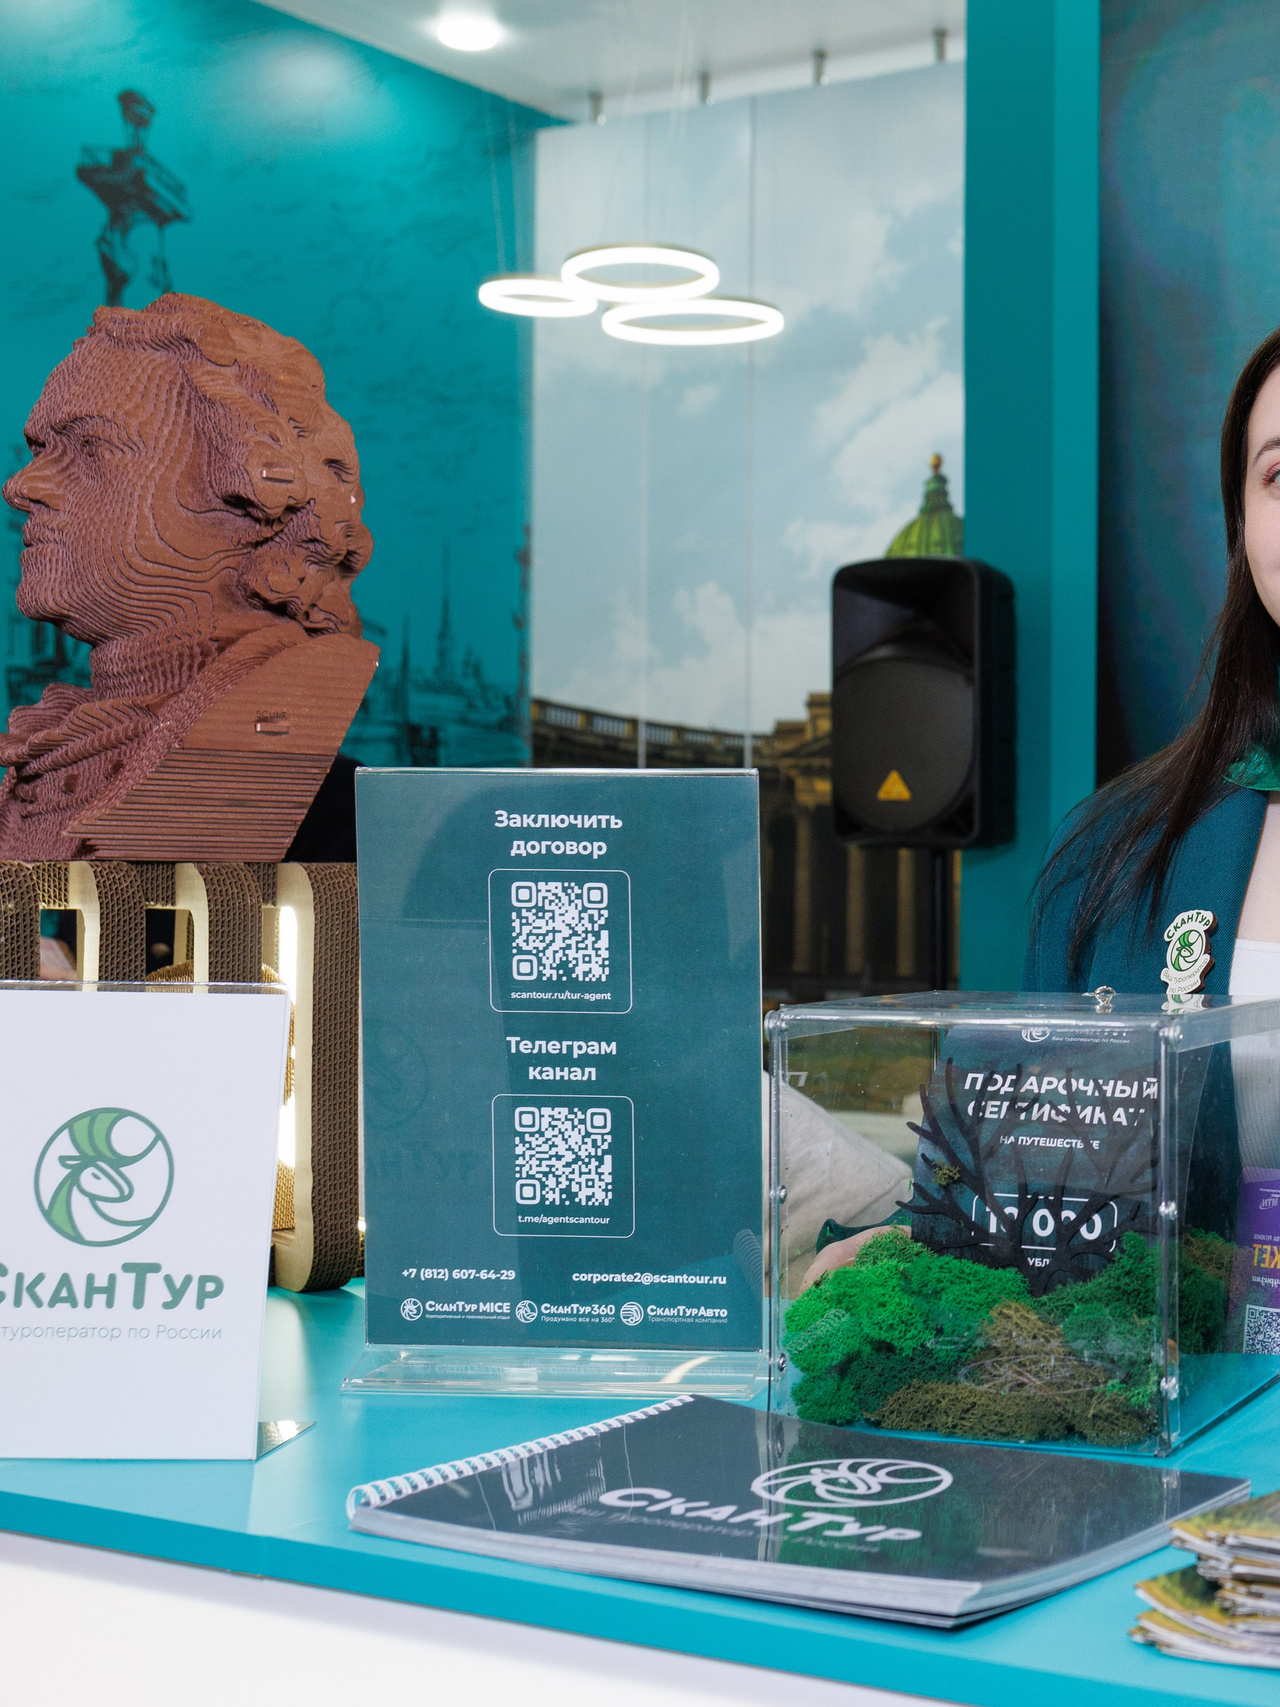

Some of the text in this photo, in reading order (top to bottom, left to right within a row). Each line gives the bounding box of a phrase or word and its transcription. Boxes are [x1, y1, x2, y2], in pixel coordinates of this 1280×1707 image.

[494, 809, 623, 829] Заключить
[511, 839, 607, 859] договор
[511, 990, 612, 1002] scantour.ru/tur-agent
[506, 1036, 617, 1058] Телеграм
[528, 1065, 597, 1081] канал
[1000, 1135, 1015, 1145] НА
[517, 1213, 610, 1226] t.me/agentscantour
[402, 1268, 516, 1281] +7 (812) 607-64-29
[572, 1272, 727, 1286] corporate2@scantour.ru
[479, 1302, 511, 1313] MICE
[541, 1315, 577, 1323] Продумано
[1, 1324, 222, 1341] туроператор по России
